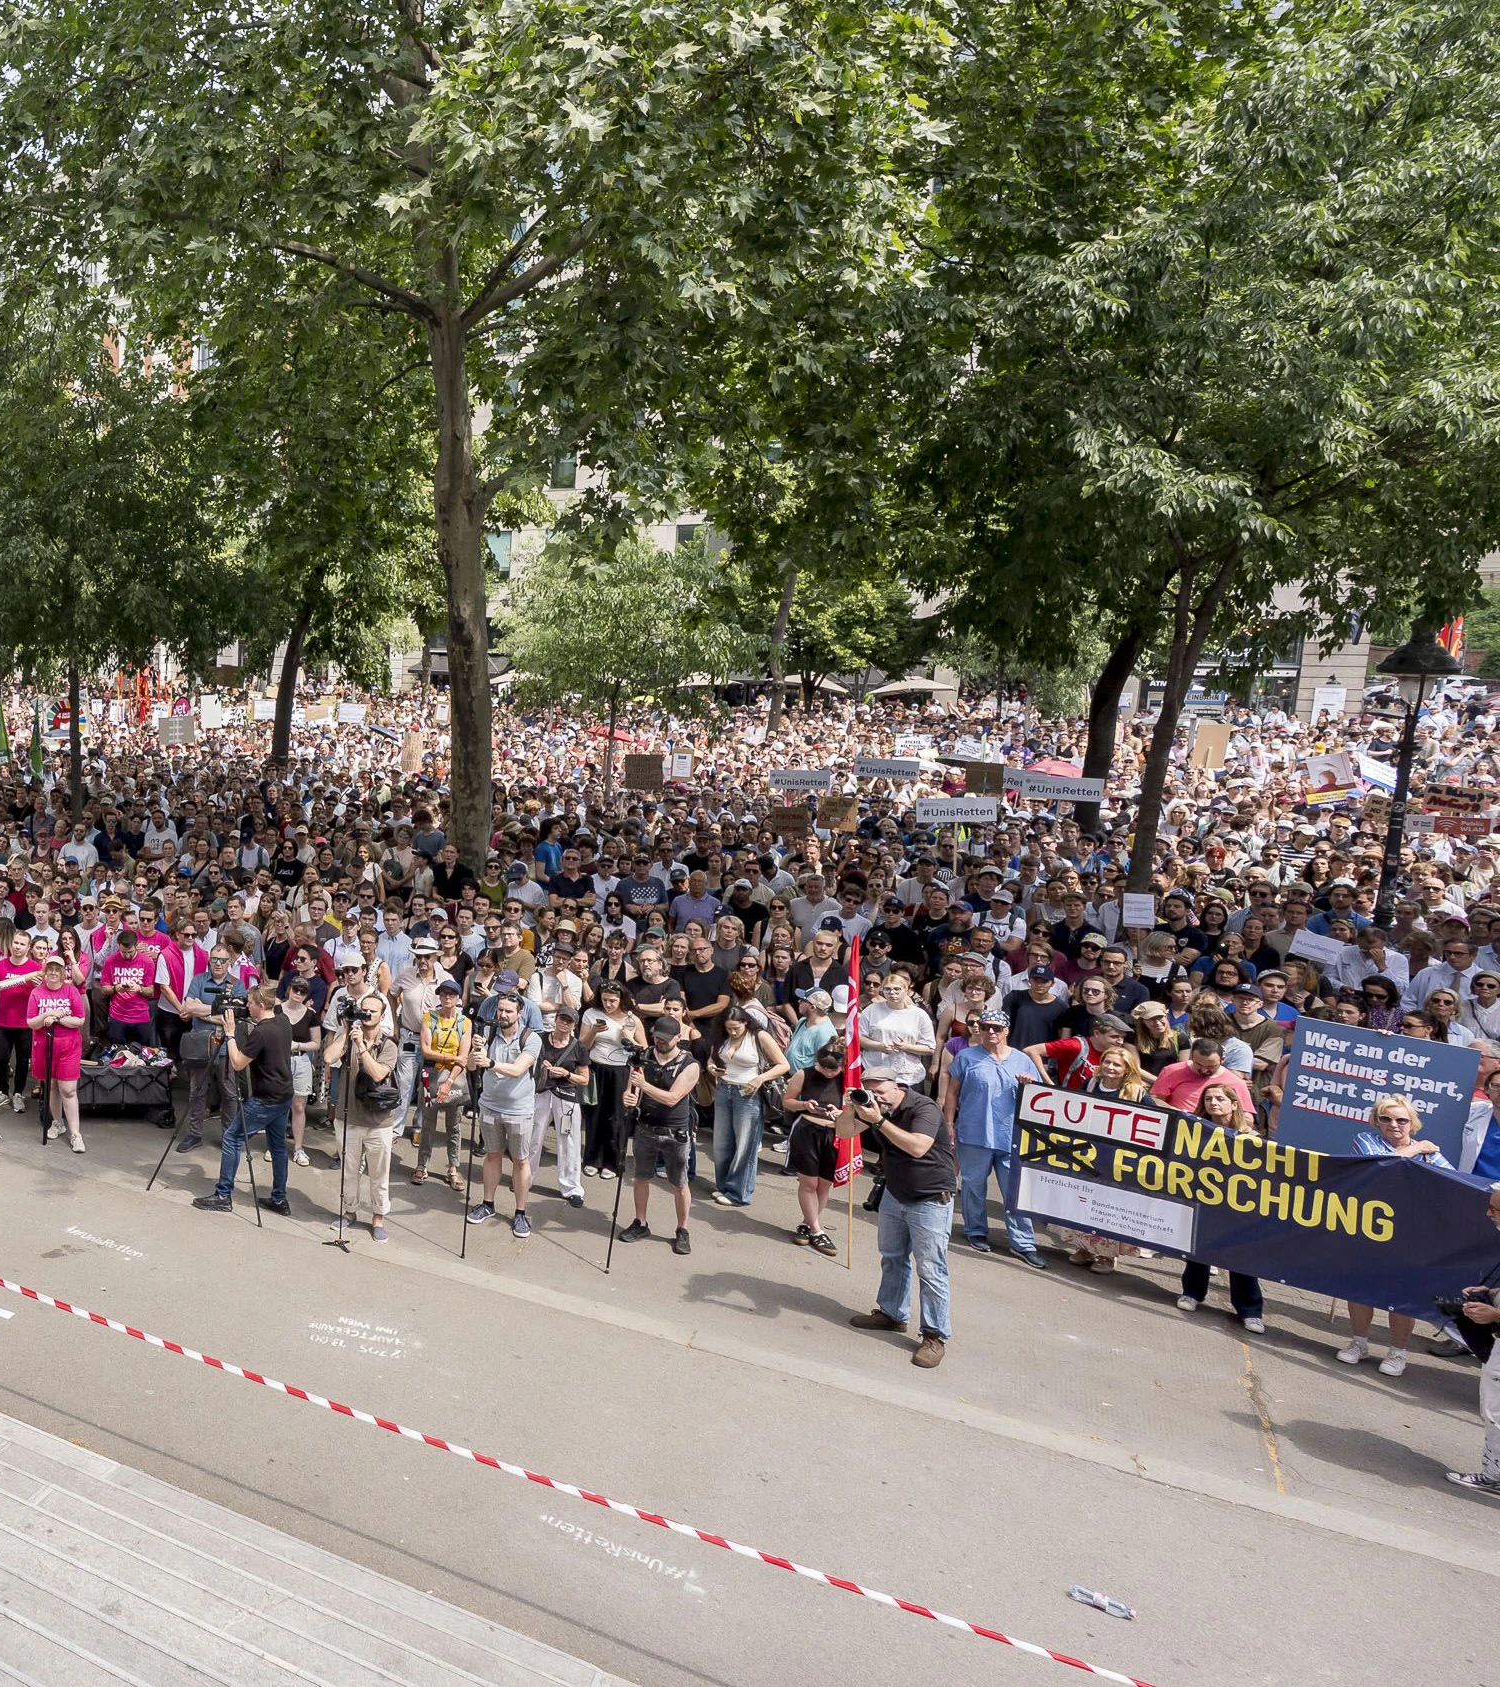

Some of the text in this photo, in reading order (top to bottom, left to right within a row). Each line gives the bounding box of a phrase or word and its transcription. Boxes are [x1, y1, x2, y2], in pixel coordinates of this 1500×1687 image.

[774, 778, 828, 786] #UnisRetten
[859, 765, 917, 777] #UnisRetten
[1028, 785, 1100, 797] #UnisRetten
[923, 807, 993, 817] #UnisRetten
[113, 967, 145, 977] JUNOS
[37, 998, 71, 1008] JUNOS
[1305, 1030, 1431, 1069] Wer an der
[1296, 1074, 1358, 1099] spart
[1300, 1051, 1464, 1102] Bildung spart,
[1292, 1091, 1373, 1123] Zukunf
[1029, 1090, 1161, 1148] GUTE
[1174, 1117, 1329, 1183] NACHT
[1040, 1175, 1094, 1194] Herzlichst Ihr
[1112, 1148, 1395, 1243] FORSCHUNG
[1090, 1207, 1174, 1234] Frauen, Wissenschaft
[1092, 1199, 1165, 1223] Bundesministerium
[1090, 1215, 1146, 1236] und Forschung
[338, 1316, 371, 1330] WIEN
